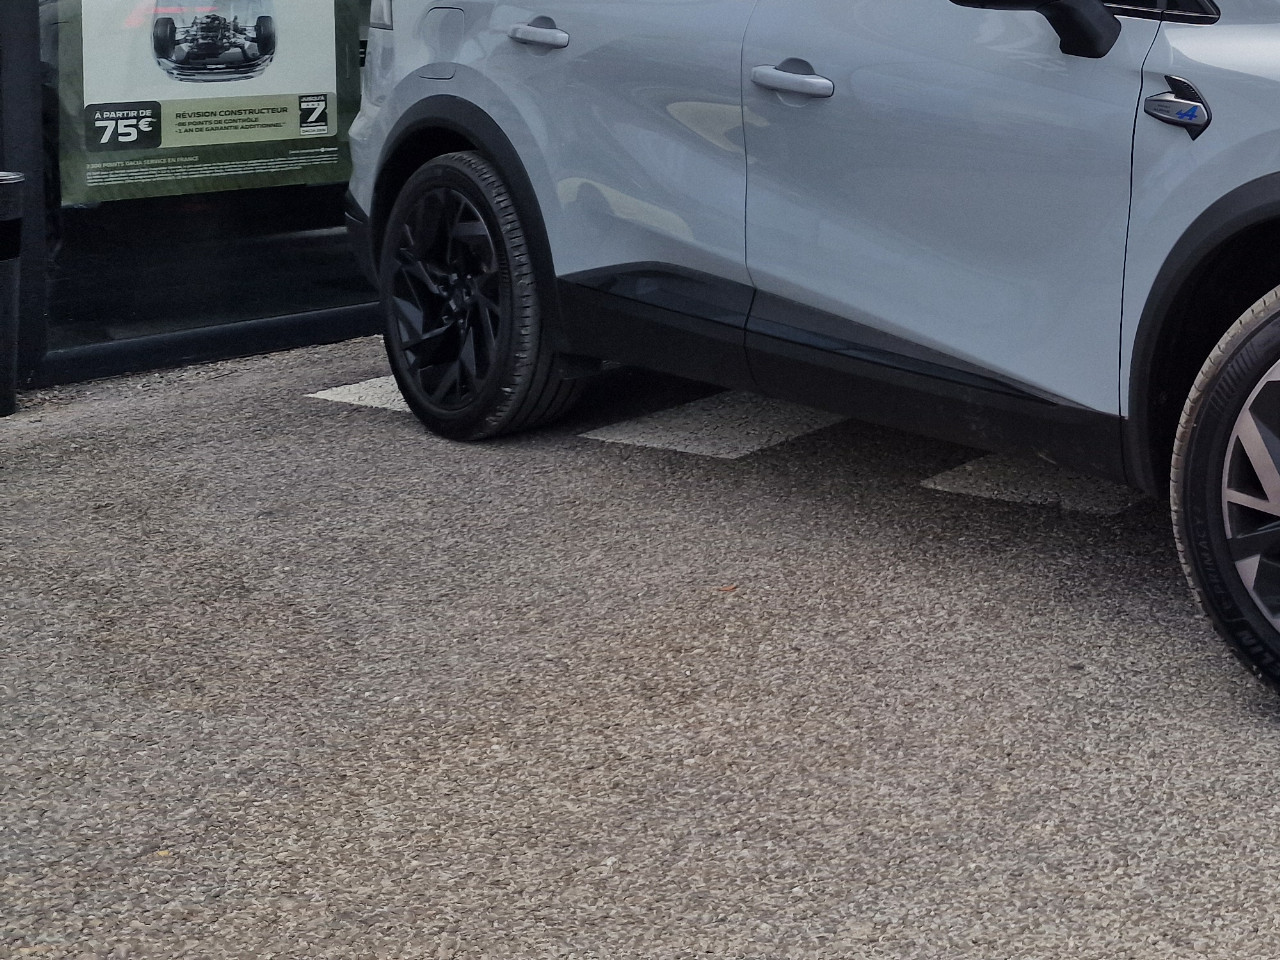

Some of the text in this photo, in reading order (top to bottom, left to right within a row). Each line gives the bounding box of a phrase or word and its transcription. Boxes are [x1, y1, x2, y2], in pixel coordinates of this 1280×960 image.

[103, 110, 138, 118] PARTIR
[139, 109, 152, 117] DE
[175, 106, 289, 120] RÉVISION CONSTRUCTEUR
[300, 101, 326, 123] 7
